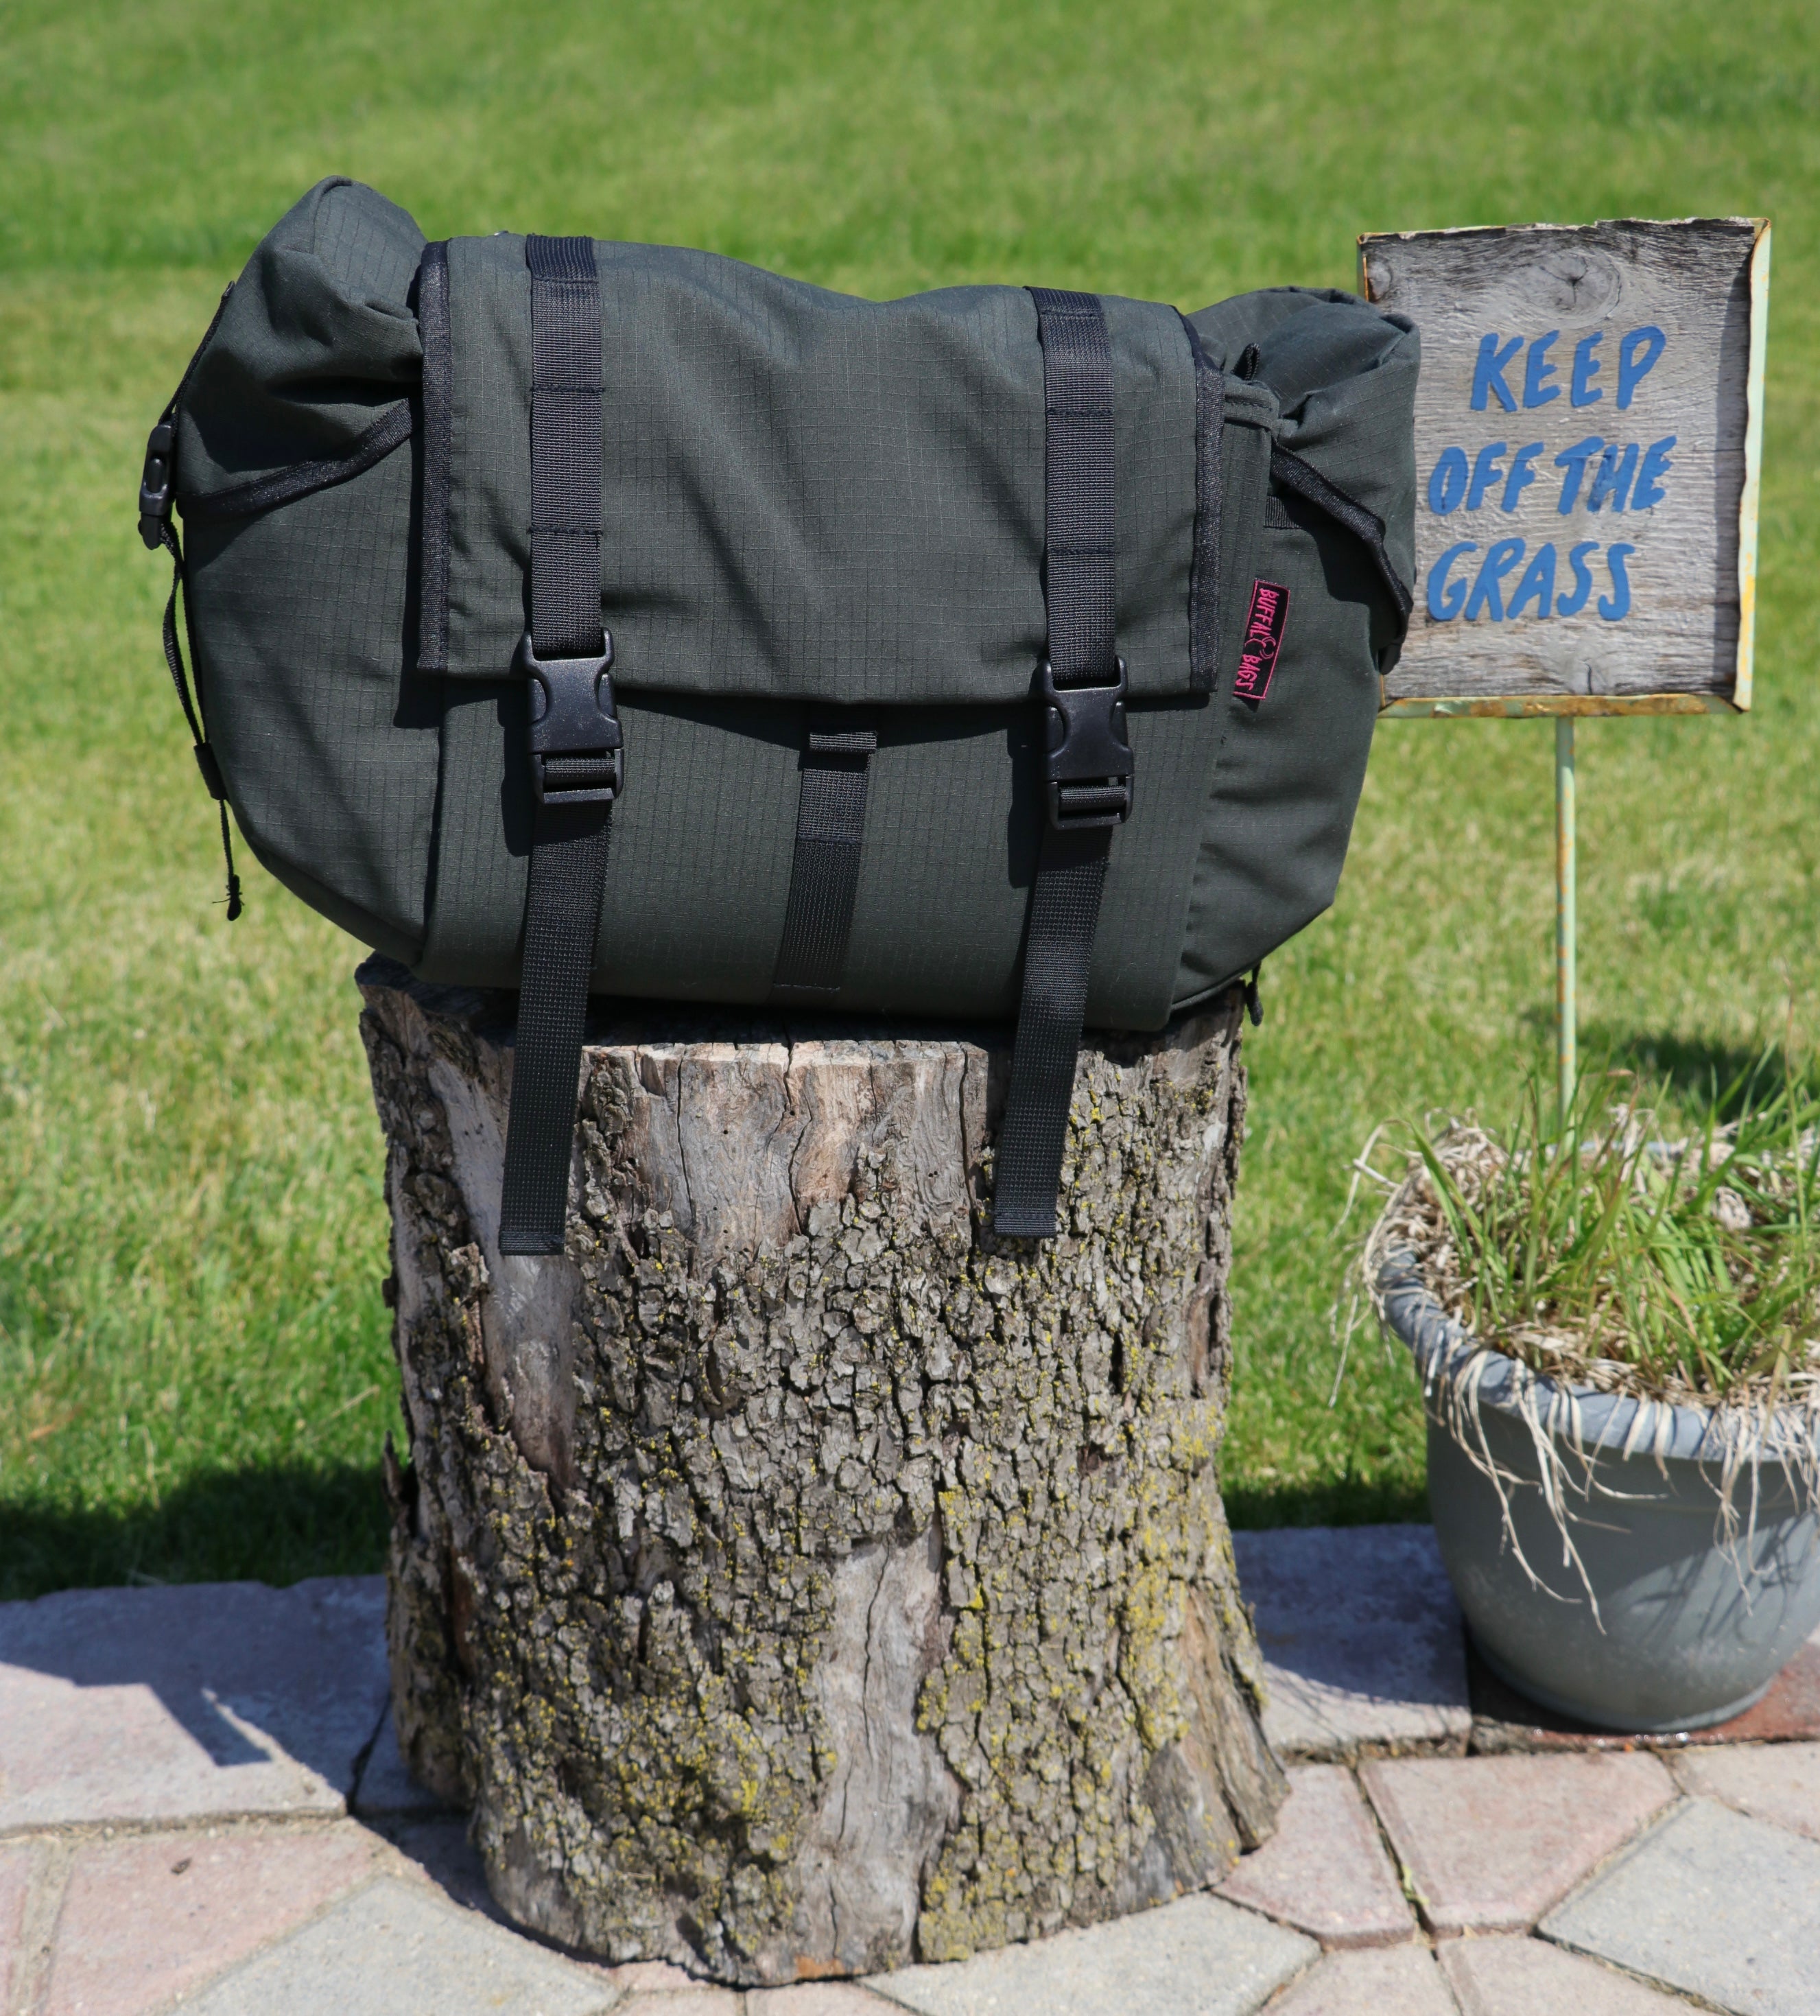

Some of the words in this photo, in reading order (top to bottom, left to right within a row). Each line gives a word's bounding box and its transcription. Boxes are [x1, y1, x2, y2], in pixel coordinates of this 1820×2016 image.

[1471, 327, 1665, 412] KEEP
[1428, 443, 1543, 515] OFF
[1555, 437, 1676, 515] THE
[1428, 539, 1634, 621] GRASS
[1234, 653, 1263, 691] BAGS
